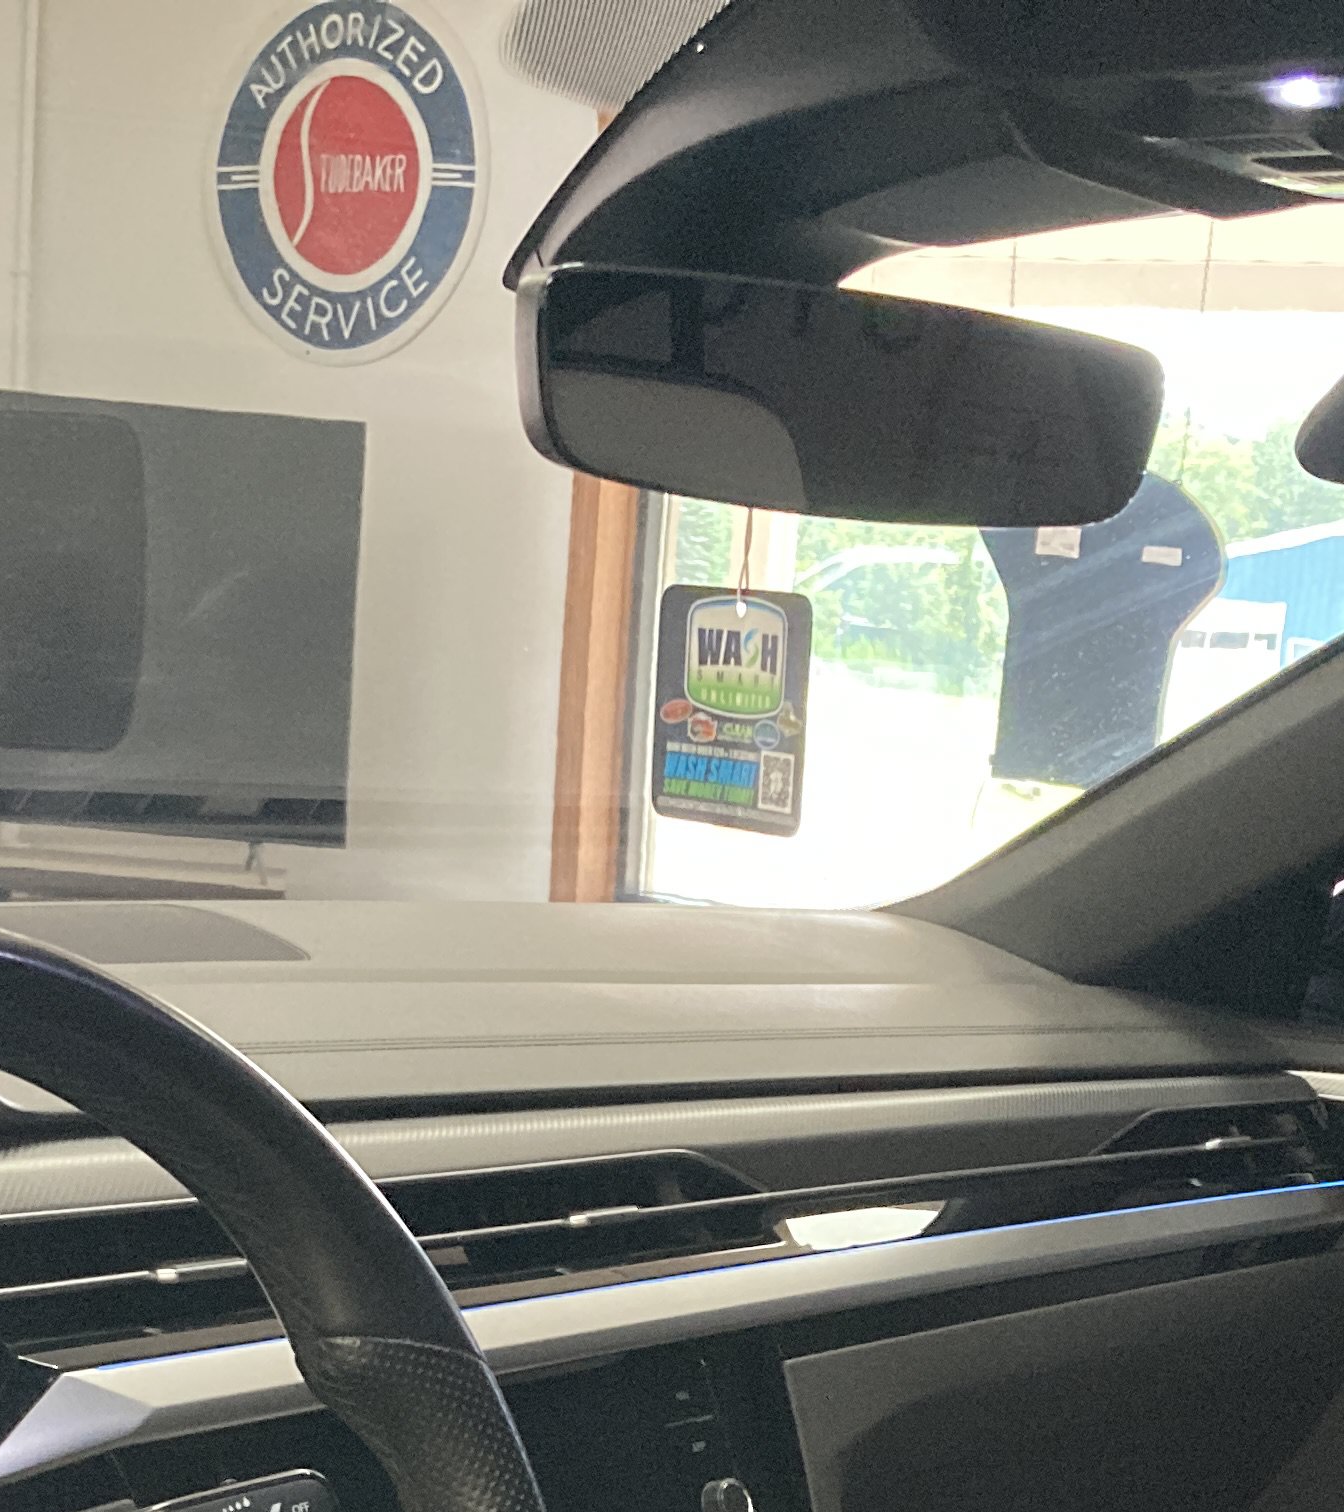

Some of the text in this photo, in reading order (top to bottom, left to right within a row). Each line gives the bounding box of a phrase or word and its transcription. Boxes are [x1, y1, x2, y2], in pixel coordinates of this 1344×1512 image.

[249, 12, 444, 108] AUTHORIZED
[262, 256, 429, 341] SERVICE
[698, 627, 779, 676] WASH
